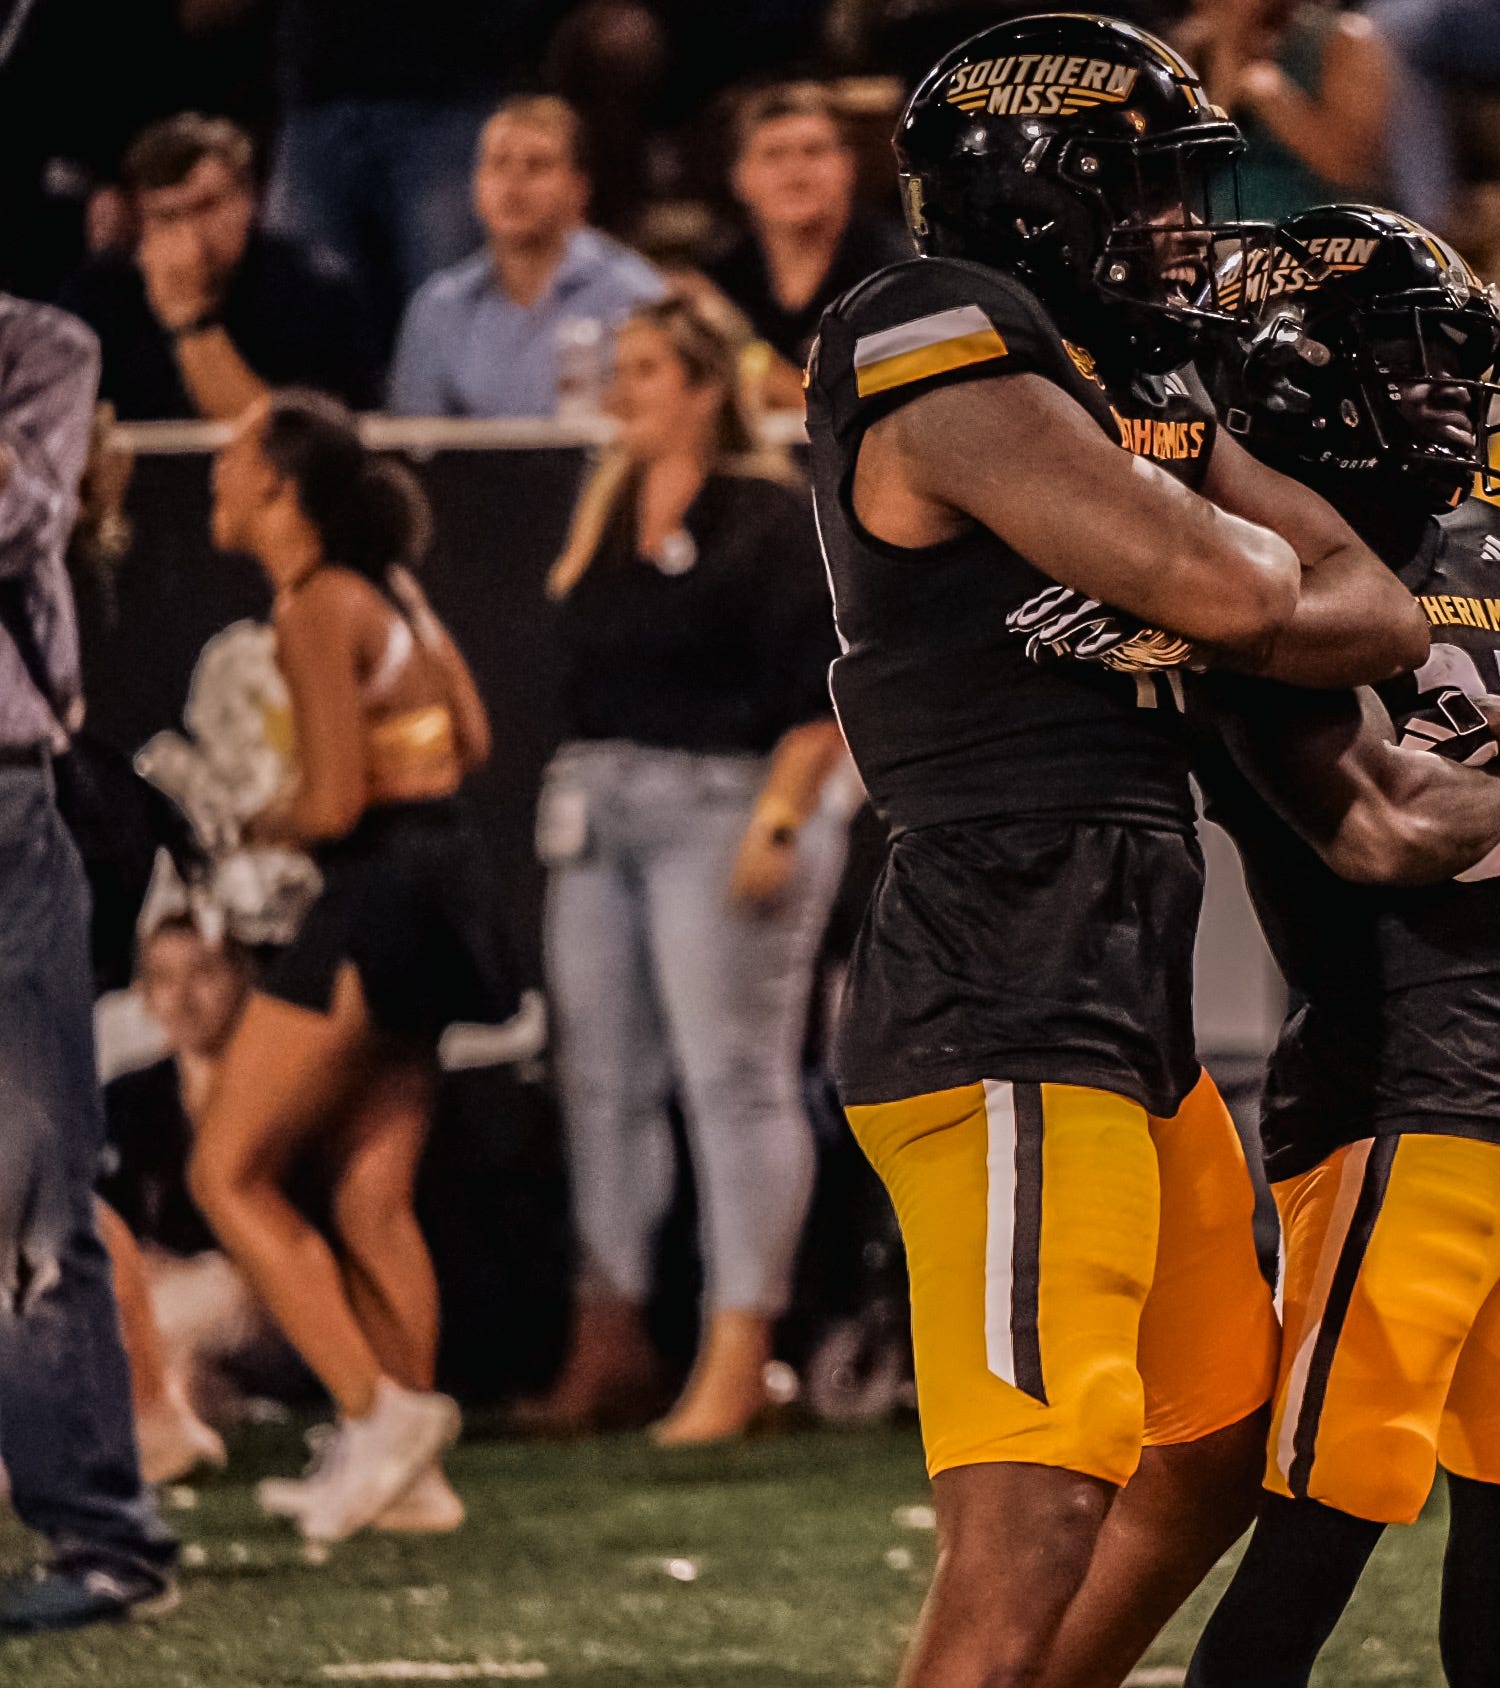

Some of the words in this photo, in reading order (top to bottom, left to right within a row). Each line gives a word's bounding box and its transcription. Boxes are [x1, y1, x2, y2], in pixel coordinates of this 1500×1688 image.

[947, 54, 1138, 98] SOUTHERN
[987, 84, 1067, 116] MISS
[1320, 451, 1367, 469] SORT
[1414, 595, 1491, 631] HERN
